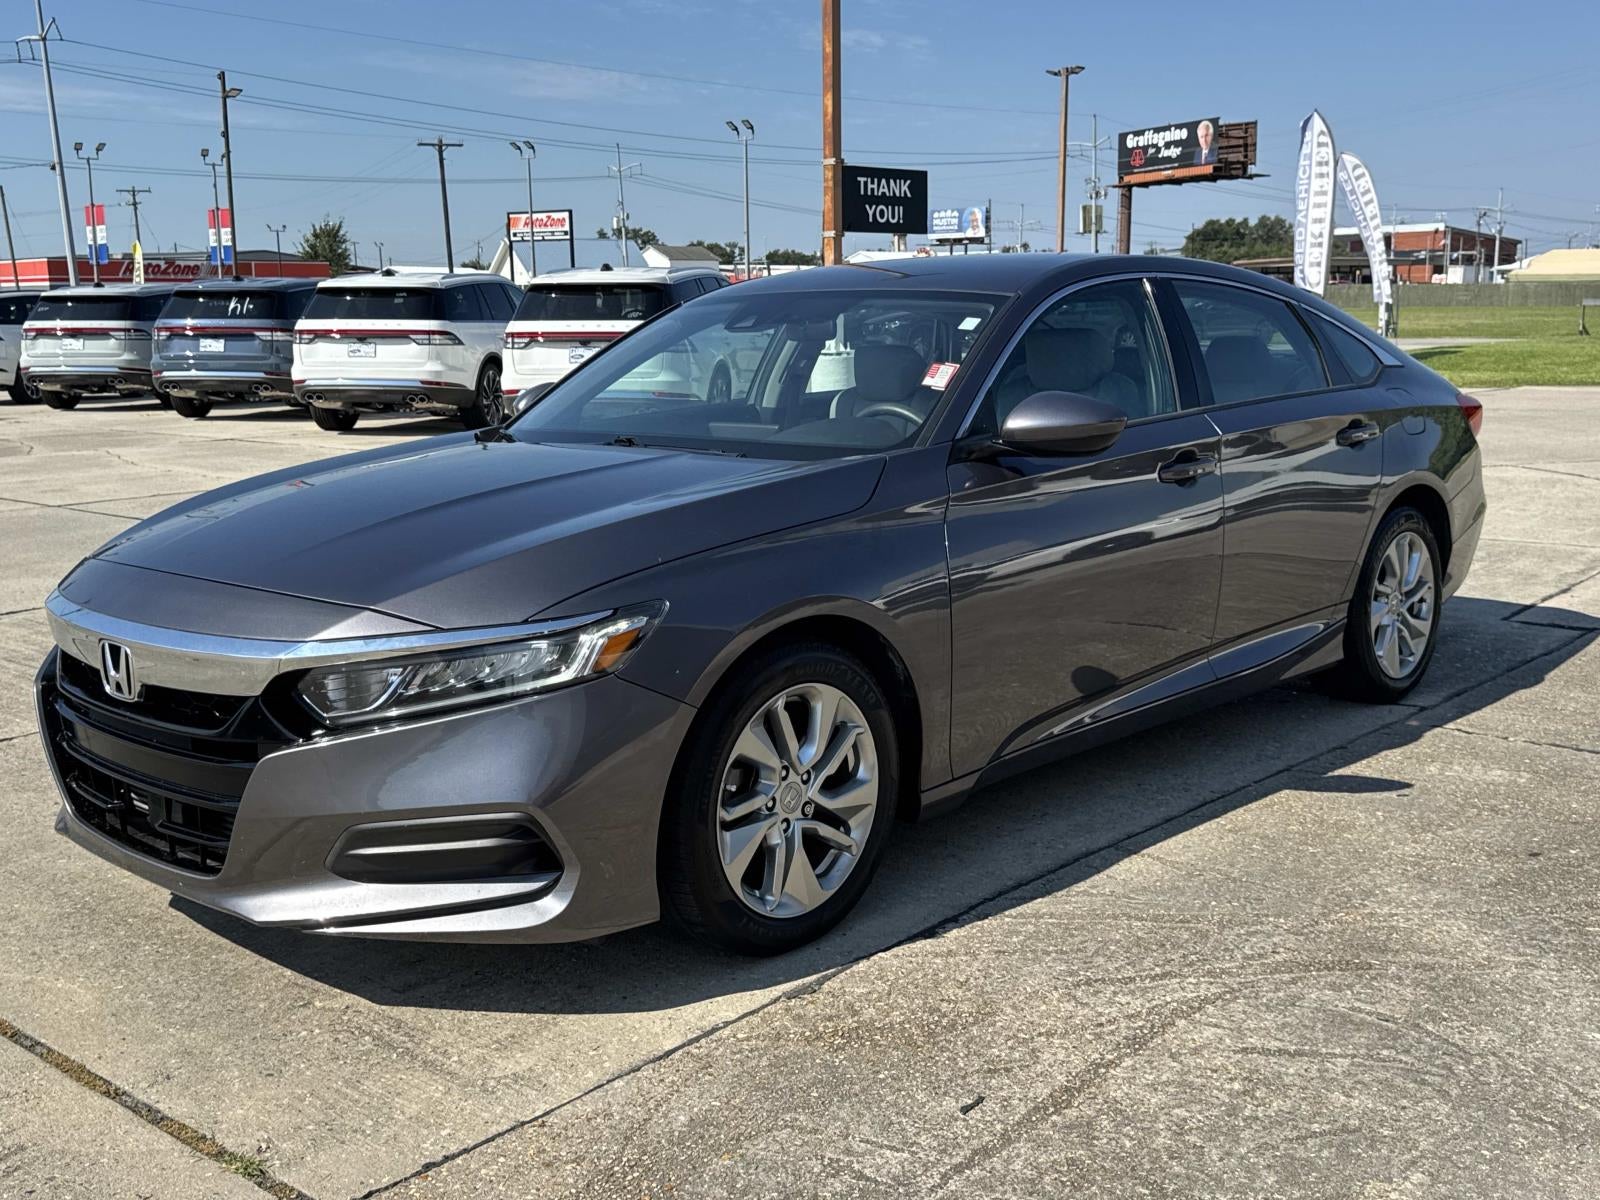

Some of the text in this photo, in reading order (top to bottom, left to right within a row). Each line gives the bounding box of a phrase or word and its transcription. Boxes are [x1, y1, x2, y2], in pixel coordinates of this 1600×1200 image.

[1126, 126, 1188, 148] Graffagnino
[1158, 144, 1182, 158] Judge
[857, 176, 912, 198] THANK
[523, 215, 566, 228] AtoZone
[865, 204, 903, 224] YOU!
[122, 258, 200, 276] AtoZone
